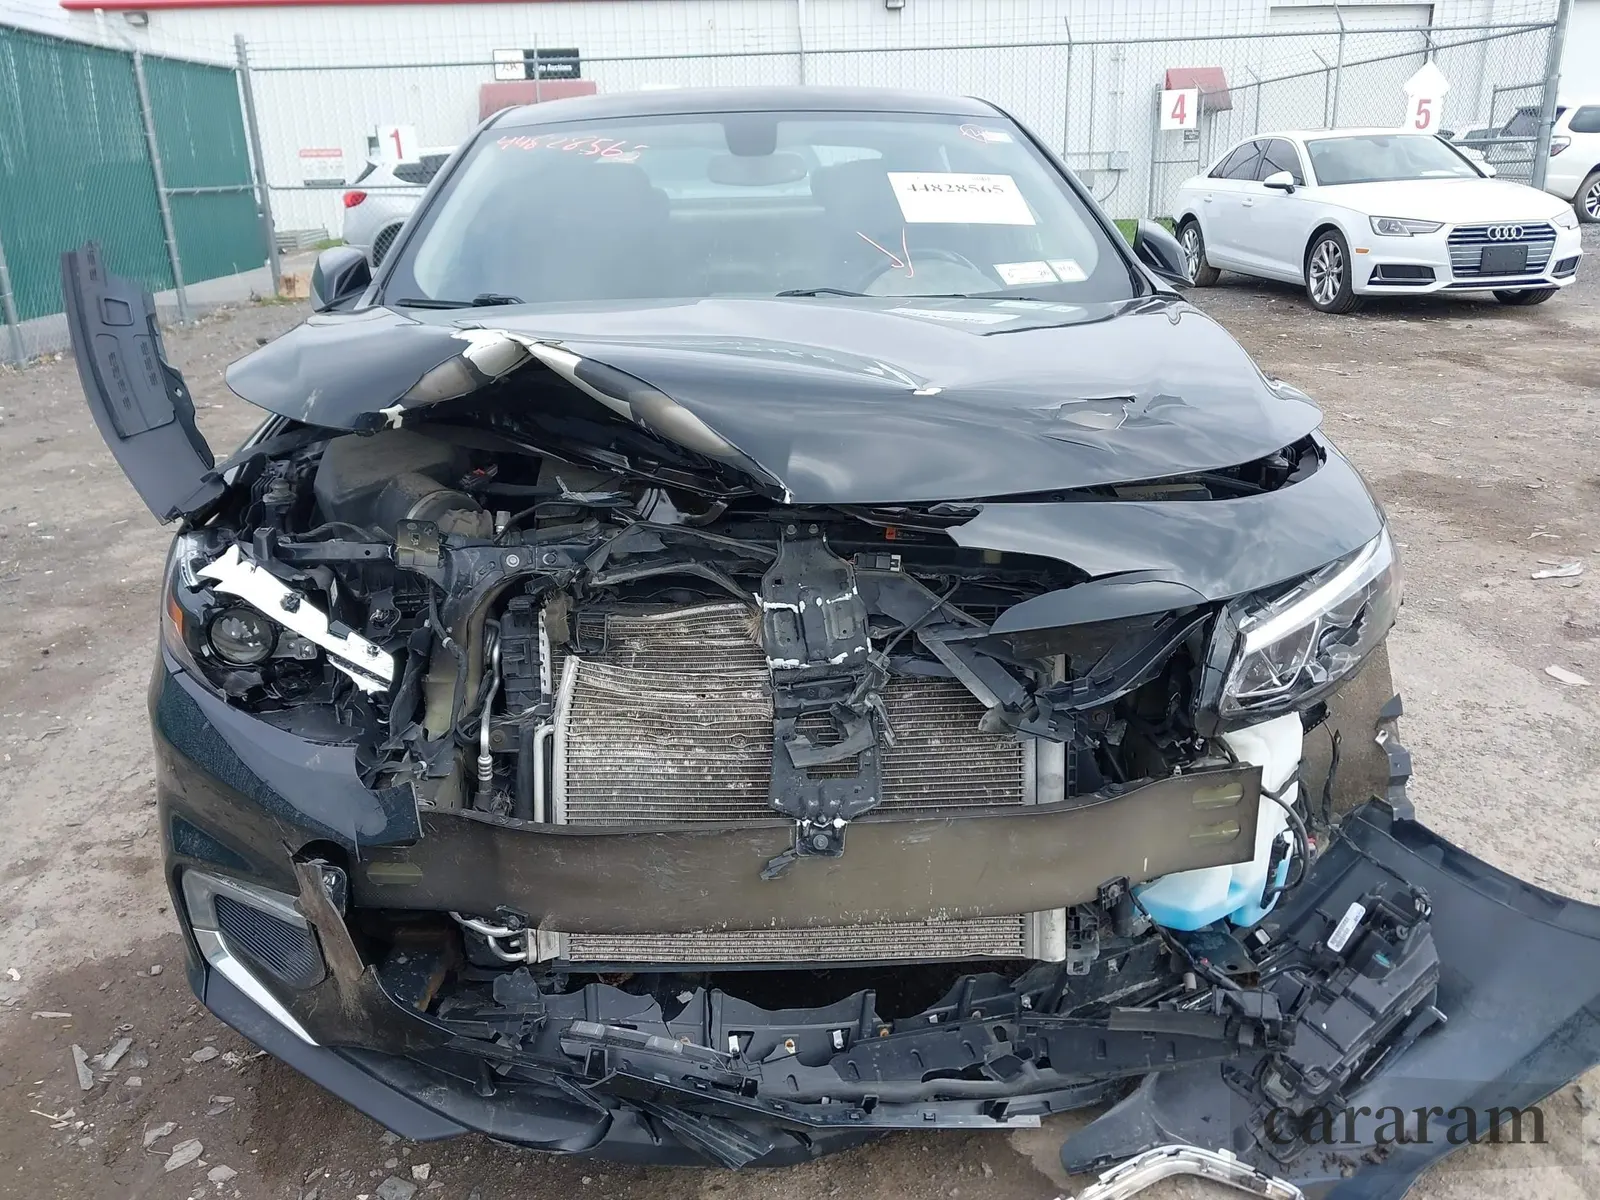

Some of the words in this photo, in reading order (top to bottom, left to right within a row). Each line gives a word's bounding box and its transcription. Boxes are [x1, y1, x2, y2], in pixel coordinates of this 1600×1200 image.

[1171, 94, 1186, 124] 4
[1415, 98, 1431, 129] 5
[390, 128, 403, 159] 1
[906, 183, 1005, 194] 44828565
